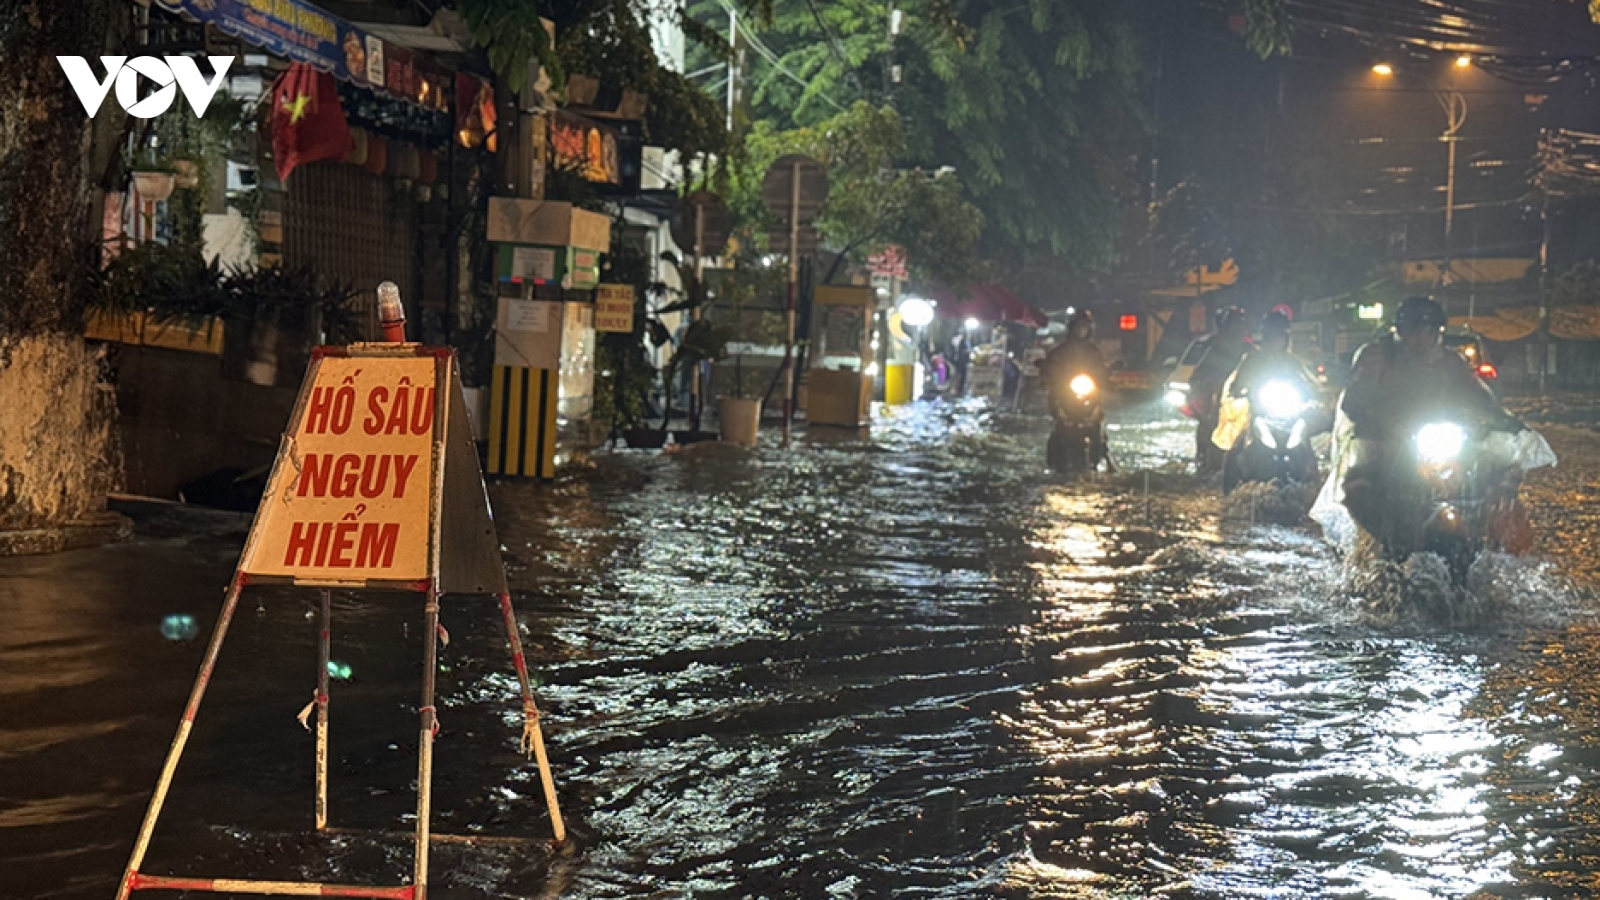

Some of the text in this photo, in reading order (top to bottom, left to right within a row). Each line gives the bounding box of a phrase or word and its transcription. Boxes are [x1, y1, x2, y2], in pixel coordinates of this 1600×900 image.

[305, 369, 435, 436] HỐ SÂU
[297, 454, 419, 498] NGUY
[284, 503, 401, 568] HIỂM
